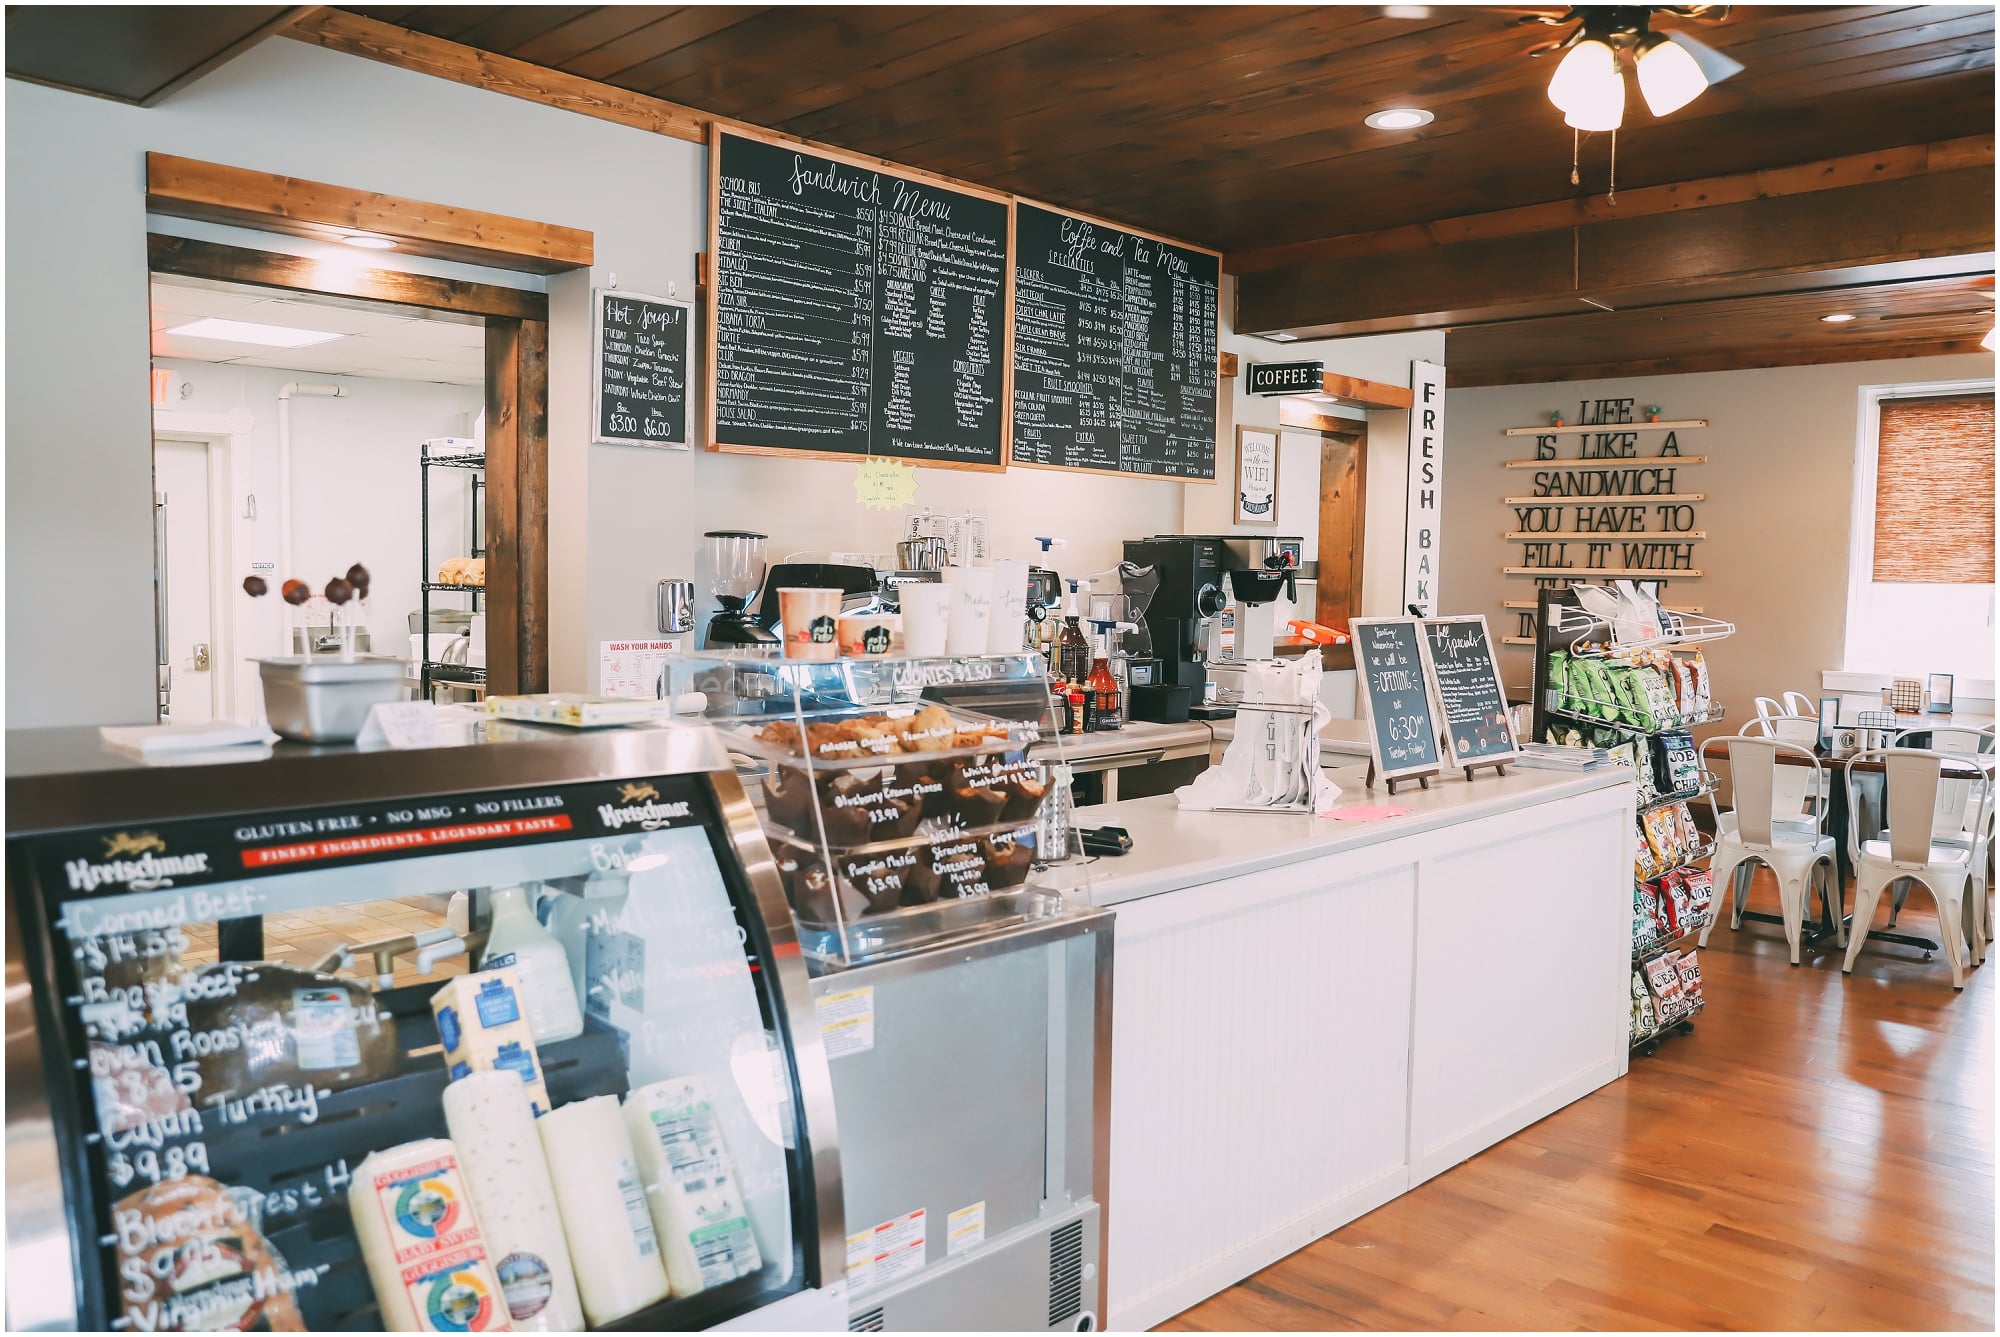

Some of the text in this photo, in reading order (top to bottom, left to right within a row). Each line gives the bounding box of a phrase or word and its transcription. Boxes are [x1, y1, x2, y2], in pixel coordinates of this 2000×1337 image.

[720, 176, 761, 195] SCHOOL BUS
[788, 154, 882, 205] Sandwich
[893, 180, 951, 221] Menu
[720, 197, 731, 208] THE
[719, 216, 731, 228] BLT
[719, 238, 741, 251] REUBEN
[1061, 217, 1188, 276] Coffee and Tea Menu
[719, 256, 748, 271] HIDALGO
[718, 276, 743, 289] BIG BEN
[718, 294, 735, 306] PIZZA
[736, 296, 748, 308] SUB
[605, 300, 634, 325] Hot
[718, 311, 766, 330] CUBANA TORTA
[1016, 305, 1066, 324] DIRTY CHAI LATTE
[634, 332, 650, 346] Taco
[652, 334, 666, 348] Soup
[718, 331, 741, 345] TURTLE
[718, 349, 734, 362] CLUB
[892, 350, 914, 366] VEGGIES
[652, 373, 668, 387] Beef
[718, 370, 729, 381] RED
[731, 371, 755, 383] DRAGON
[1043, 377, 1062, 391] FRUIT
[1256, 368, 1308, 386] COFFEE
[630, 387, 648, 400] White
[718, 388, 750, 401] NORMANDY
[1037, 393, 1050, 403] FRUIT
[717, 407, 736, 419] HOUSE
[737, 408, 757, 421] SALAD
[1028, 403, 1046, 412] COLADA
[1580, 398, 1634, 426] LIFE
[609, 413, 672, 438] $3.00 $6.00
[1024, 428, 1042, 440] FRUITS
[1076, 432, 1095, 444] EXTRAS
[1140, 435, 1148, 444] TEA
[1122, 445, 1141, 455] HOT TEA
[1420, 382, 1436, 510] FRESH
[1535, 431, 1682, 461] IS LIKE A
[1244, 466, 1269, 482] WIFI
[1533, 468, 1677, 497] SANDWICH
[1514, 504, 1695, 533] YOU HAVE TO
[1522, 543, 1695, 570] FILL IT WITH
[610, 642, 673, 652] WASH YOUR HANDS
[894, 664, 992, 685] COOKIES $1.50
[1379, 670, 1412, 693] OPENING
[1670, 750, 1695, 763] JOE
[235, 795, 564, 842] GLUTEN FREE NO MSG NO FILLERS
[598, 799, 692, 830] Kretschmar
[260, 817, 561, 863] FINEST INGREDIENTS. LEGENDARY TASTE.
[65, 852, 208, 892] Kretschmar
[1692, 886, 1712, 901] JOE
[1683, 966, 1701, 984] JOE
[108, 1142, 211, 1188] $9.89
